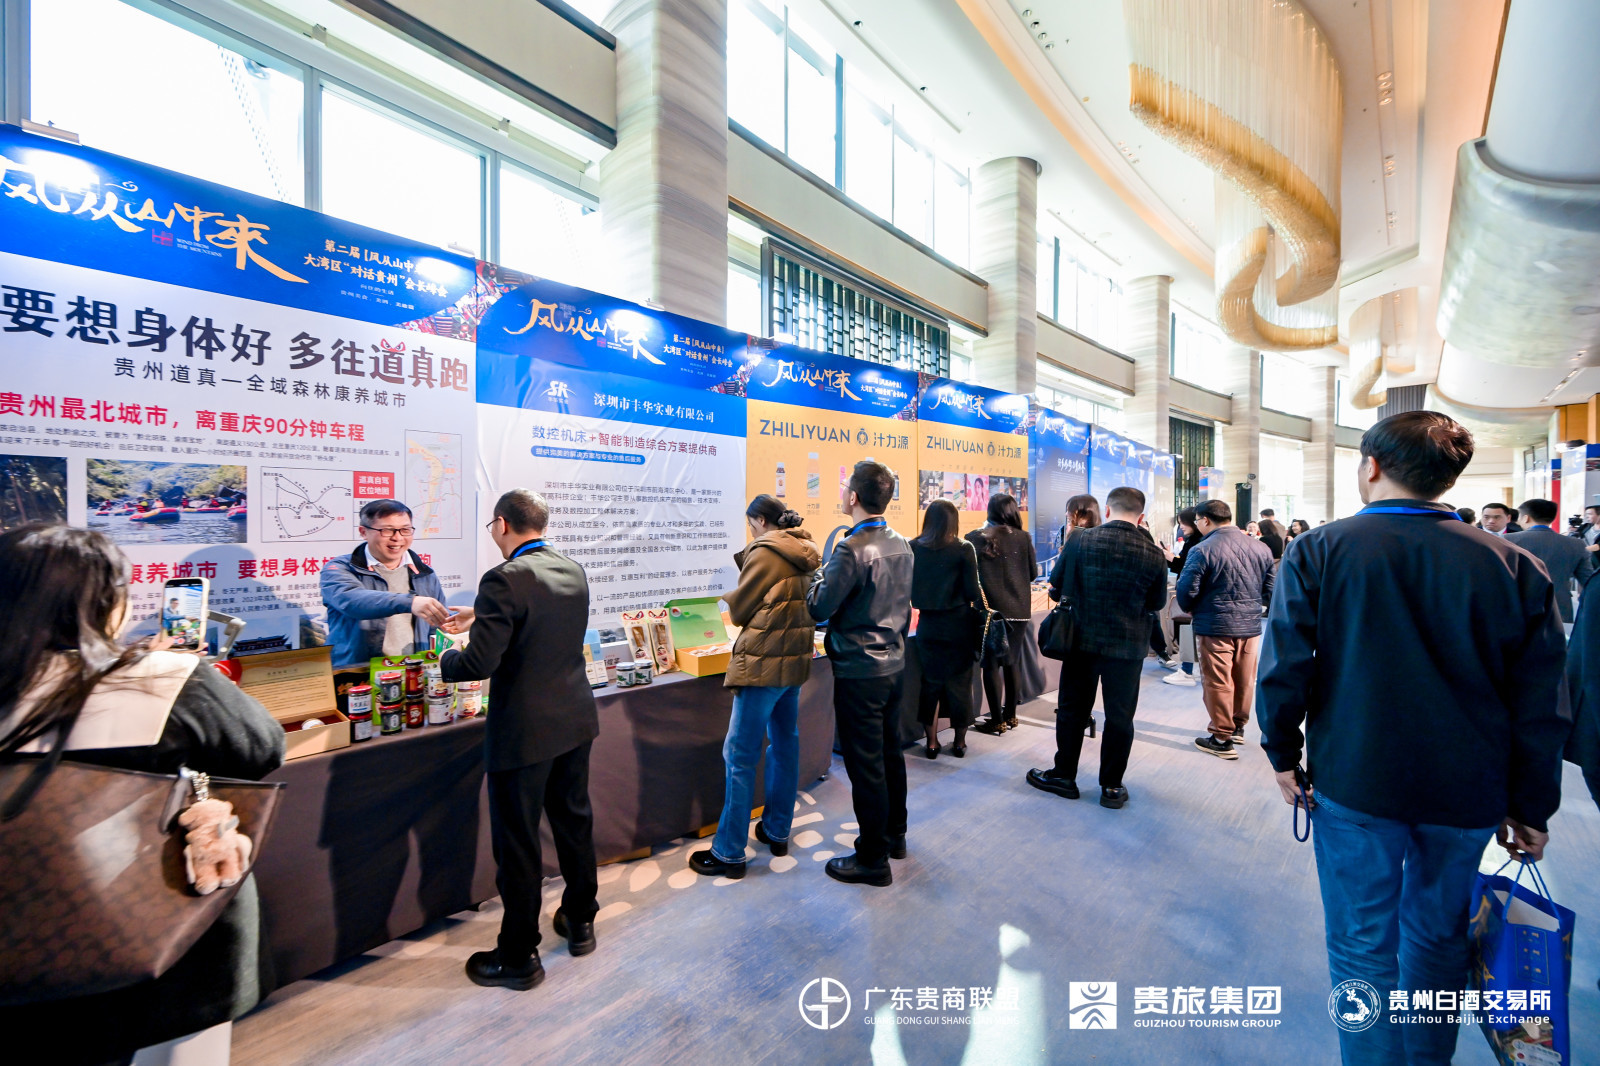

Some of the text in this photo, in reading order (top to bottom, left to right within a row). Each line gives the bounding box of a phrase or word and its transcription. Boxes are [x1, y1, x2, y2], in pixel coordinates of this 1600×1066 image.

[0, 284, 469, 392] 要想身体好 多往道真跑
[593, 392, 714, 424] 深圳市丰华实业有限公司
[759, 419, 850, 443] ZHILIYUAN
[873, 432, 909, 450] 汁力源
[926, 435, 984, 454] ZHILIYUAN
[997, 445, 1022, 459] 汁力源
